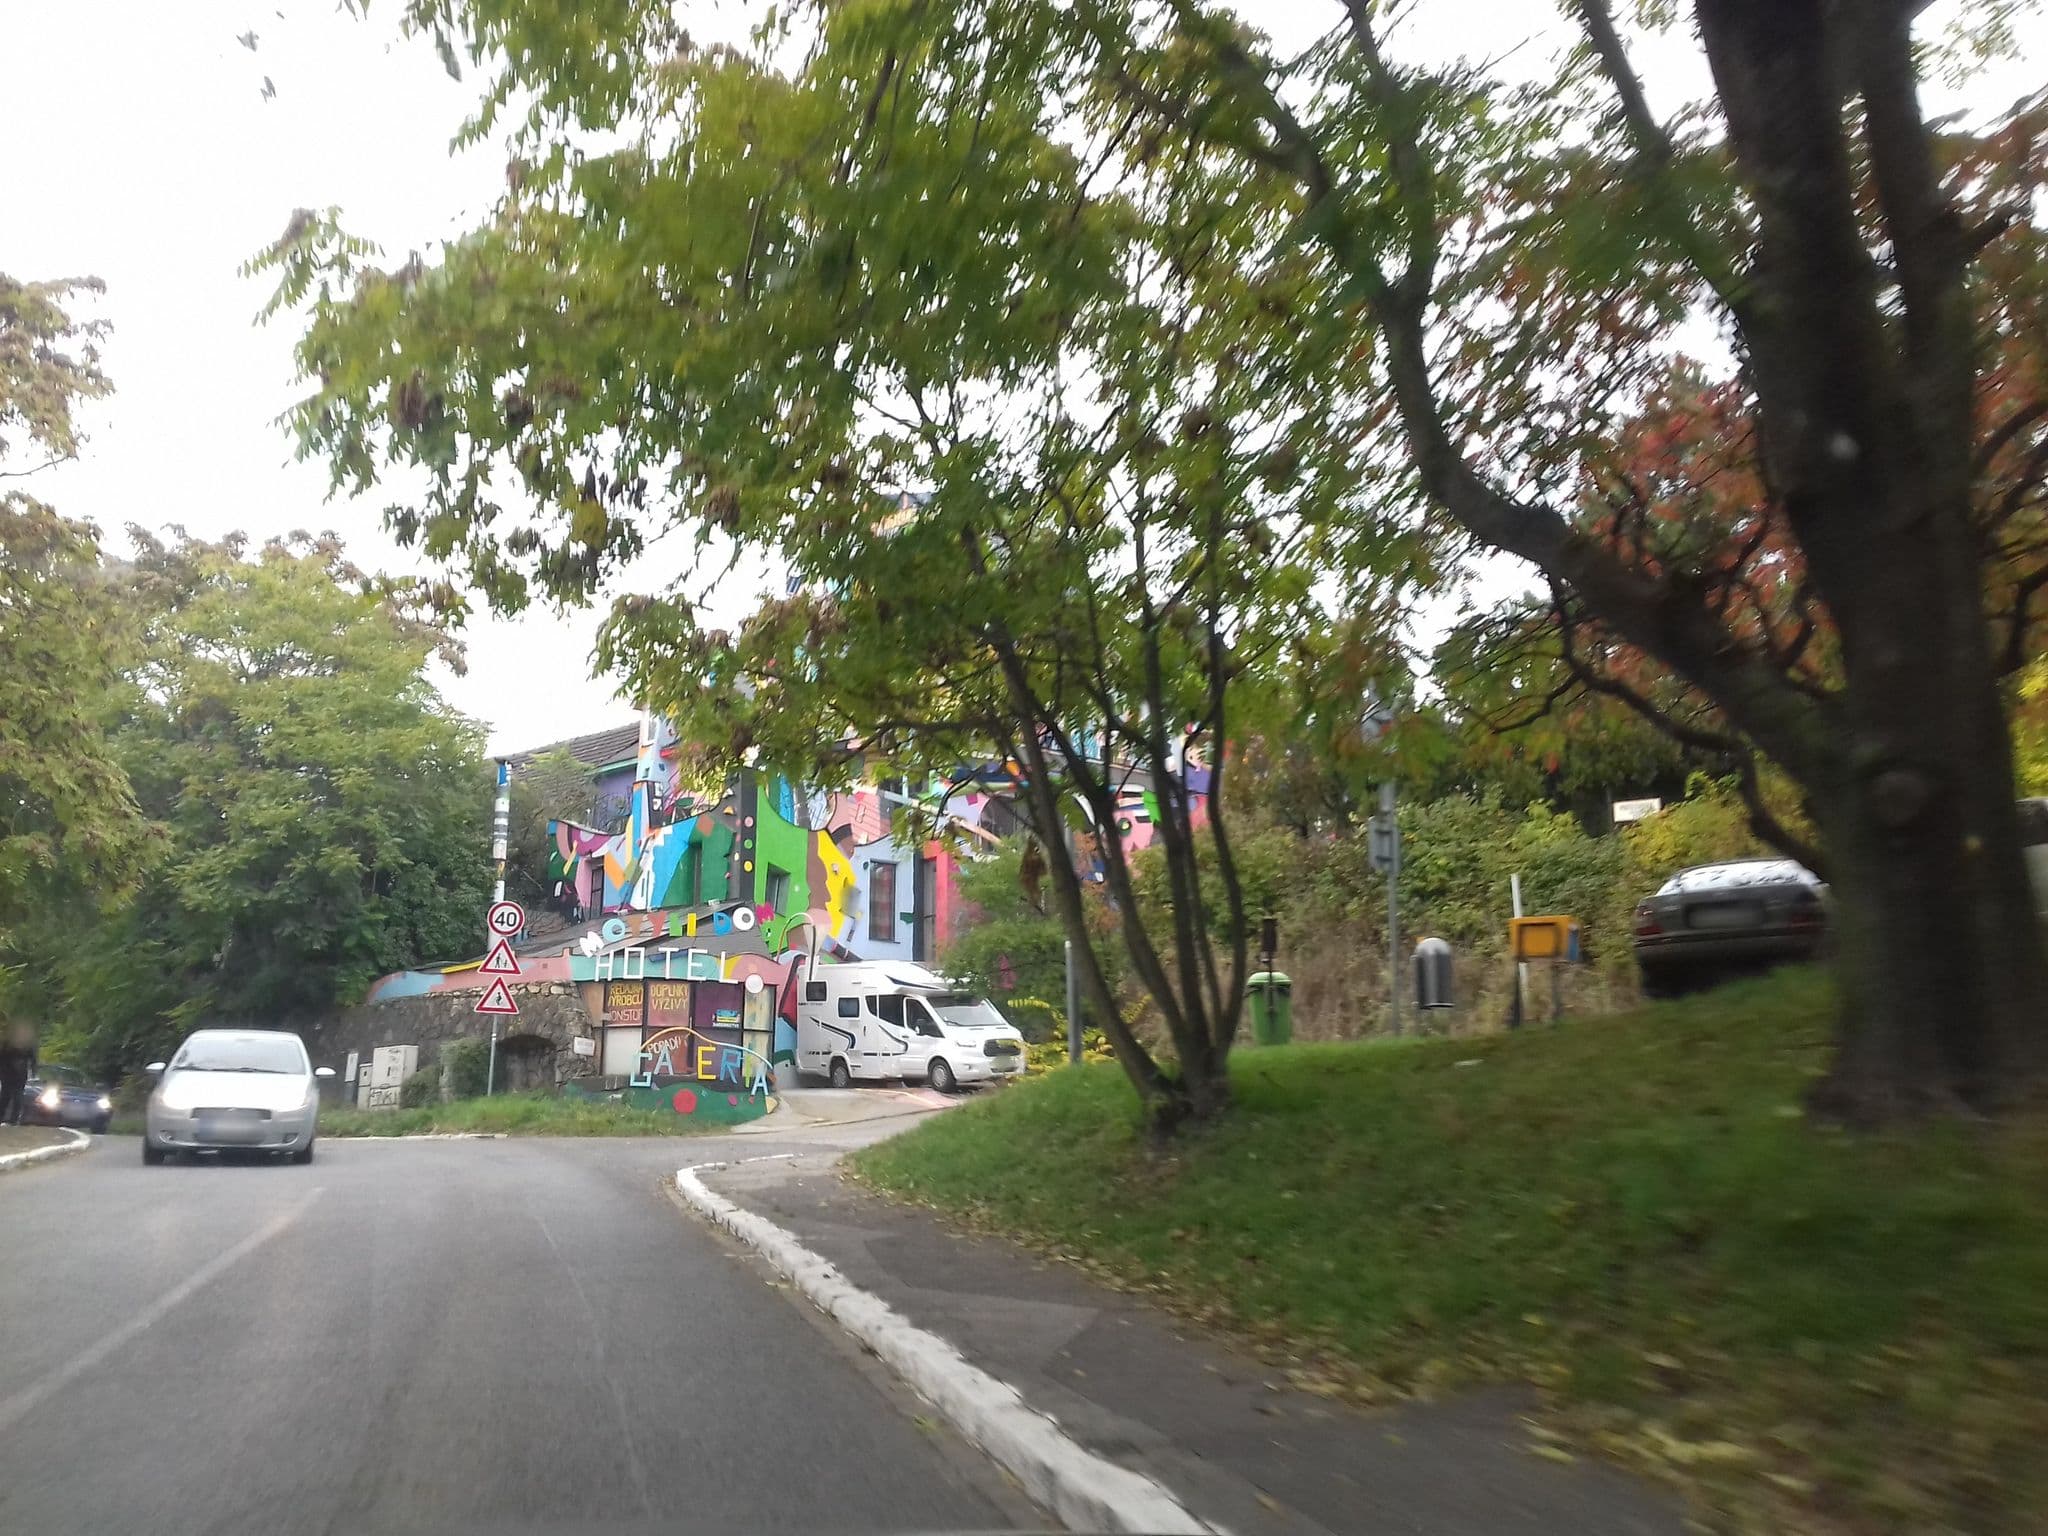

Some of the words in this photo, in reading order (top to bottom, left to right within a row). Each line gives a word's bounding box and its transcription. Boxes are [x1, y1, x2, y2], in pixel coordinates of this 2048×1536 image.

[495, 912, 517, 927] 40
[713, 901, 775, 937] DOM
[594, 947, 738, 984] HOTEL
